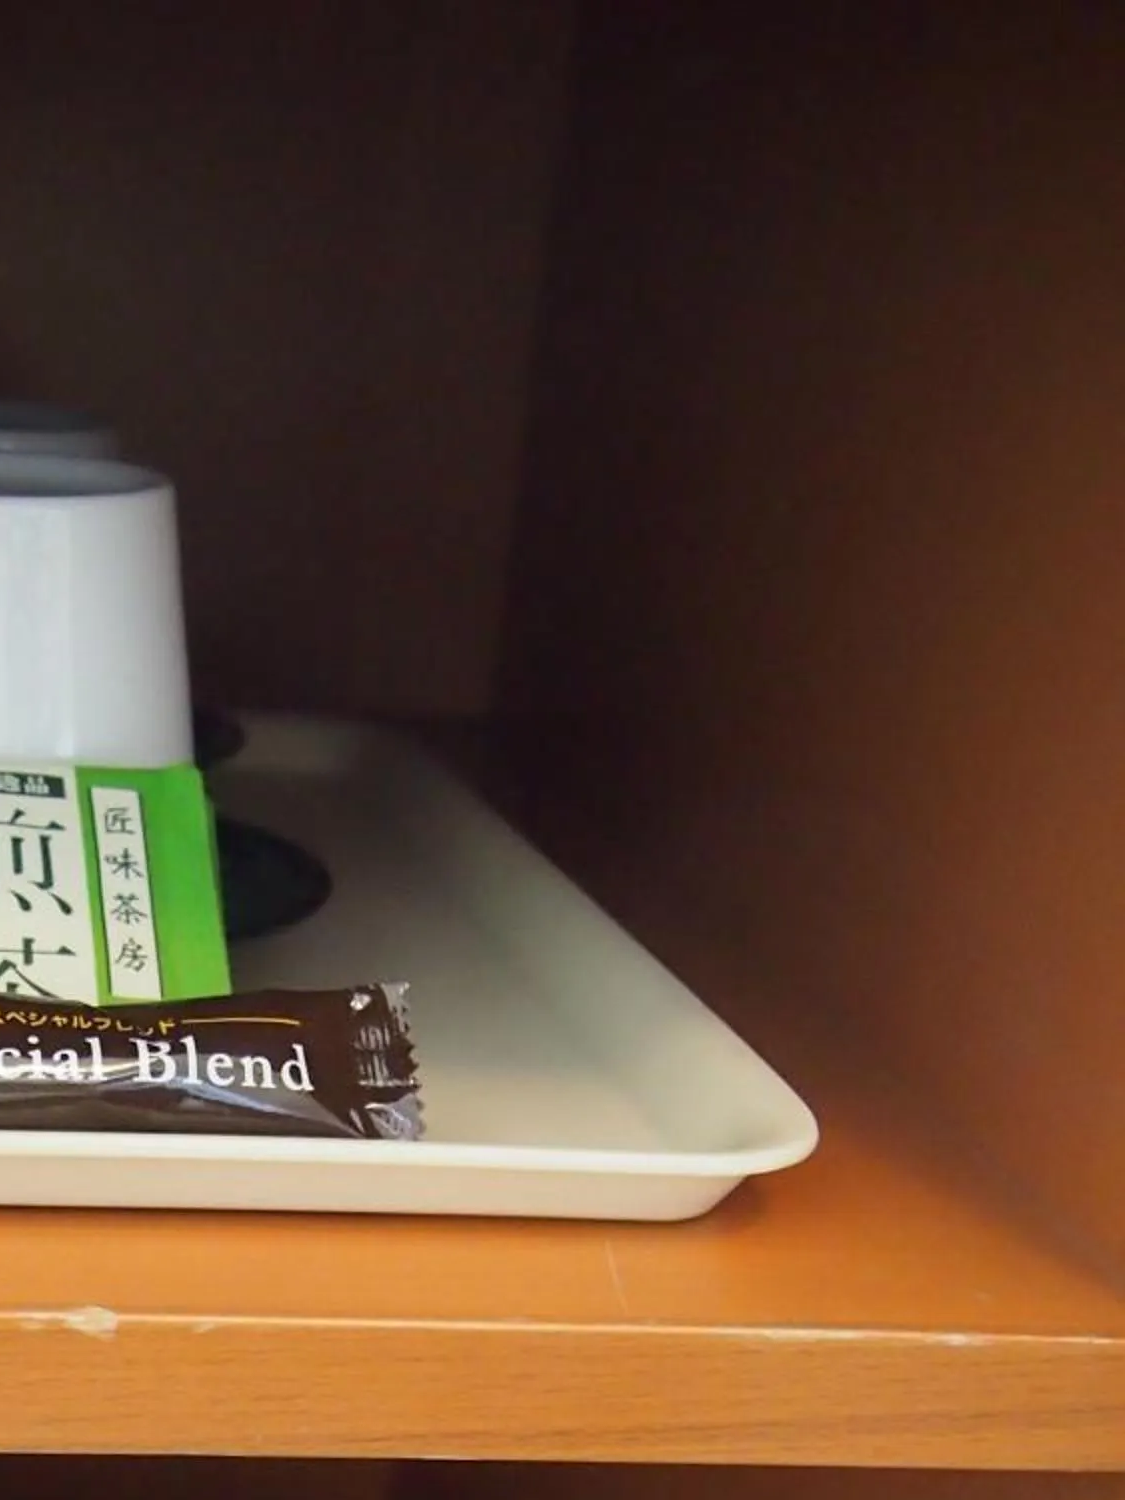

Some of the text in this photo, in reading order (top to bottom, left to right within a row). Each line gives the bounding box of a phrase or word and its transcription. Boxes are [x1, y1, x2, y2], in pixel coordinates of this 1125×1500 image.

[103, 807, 149, 973] 匠味茶房
[130, 1036, 316, 1093] Blend
